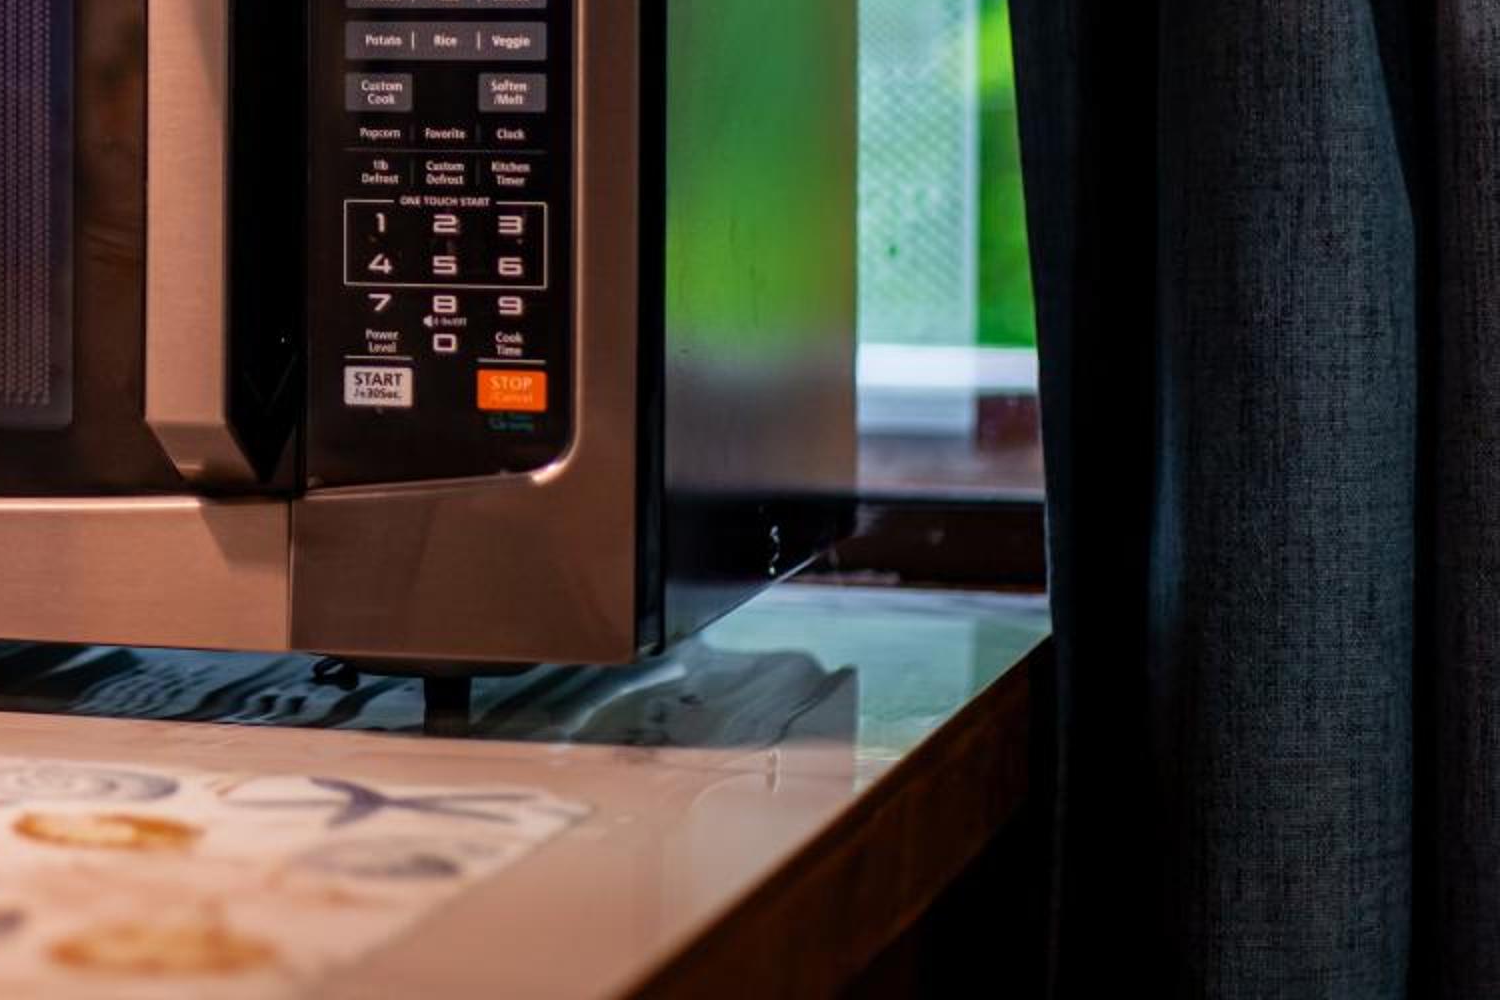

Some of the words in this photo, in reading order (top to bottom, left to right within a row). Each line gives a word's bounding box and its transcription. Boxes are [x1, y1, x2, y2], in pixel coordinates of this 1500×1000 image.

[365, 34, 402, 46] Potato
[433, 34, 458, 46] Rice
[492, 34, 531, 49] Veggie
[361, 80, 403, 92] Custom
[491, 80, 528, 92] Soften
[367, 93, 396, 105] Cook
[360, 127, 401, 140] Popcorn
[425, 127, 466, 139] Favorite
[496, 128, 524, 140] Clock
[425, 160, 465, 172] Custom
[491, 160, 531, 173] Kitchen
[361, 173, 399, 185] Defrost
[426, 174, 464, 186] Defrost
[497, 174, 525, 187] Timer
[400, 196, 421, 205] ONE
[424, 196, 457, 206] TOUCH
[459, 197, 490, 206] START
[376, 212, 386, 233] 1
[433, 214, 458, 234] 2
[497, 215, 523, 235] 3
[368, 253, 393, 275] 4
[433, 255, 457, 275] 5
[498, 257, 523, 276] 6
[368, 293, 392, 312] 7
[433, 295, 457, 314] 8
[498, 296, 523, 315] 9
[365, 329, 398, 341] Power
[495, 332, 522, 344] Cook
[368, 342, 397, 354] Level
[433, 333, 457, 352] 0
[497, 345, 522, 357] Time
[354, 372, 403, 387] START
[491, 375, 533, 390] STOP
